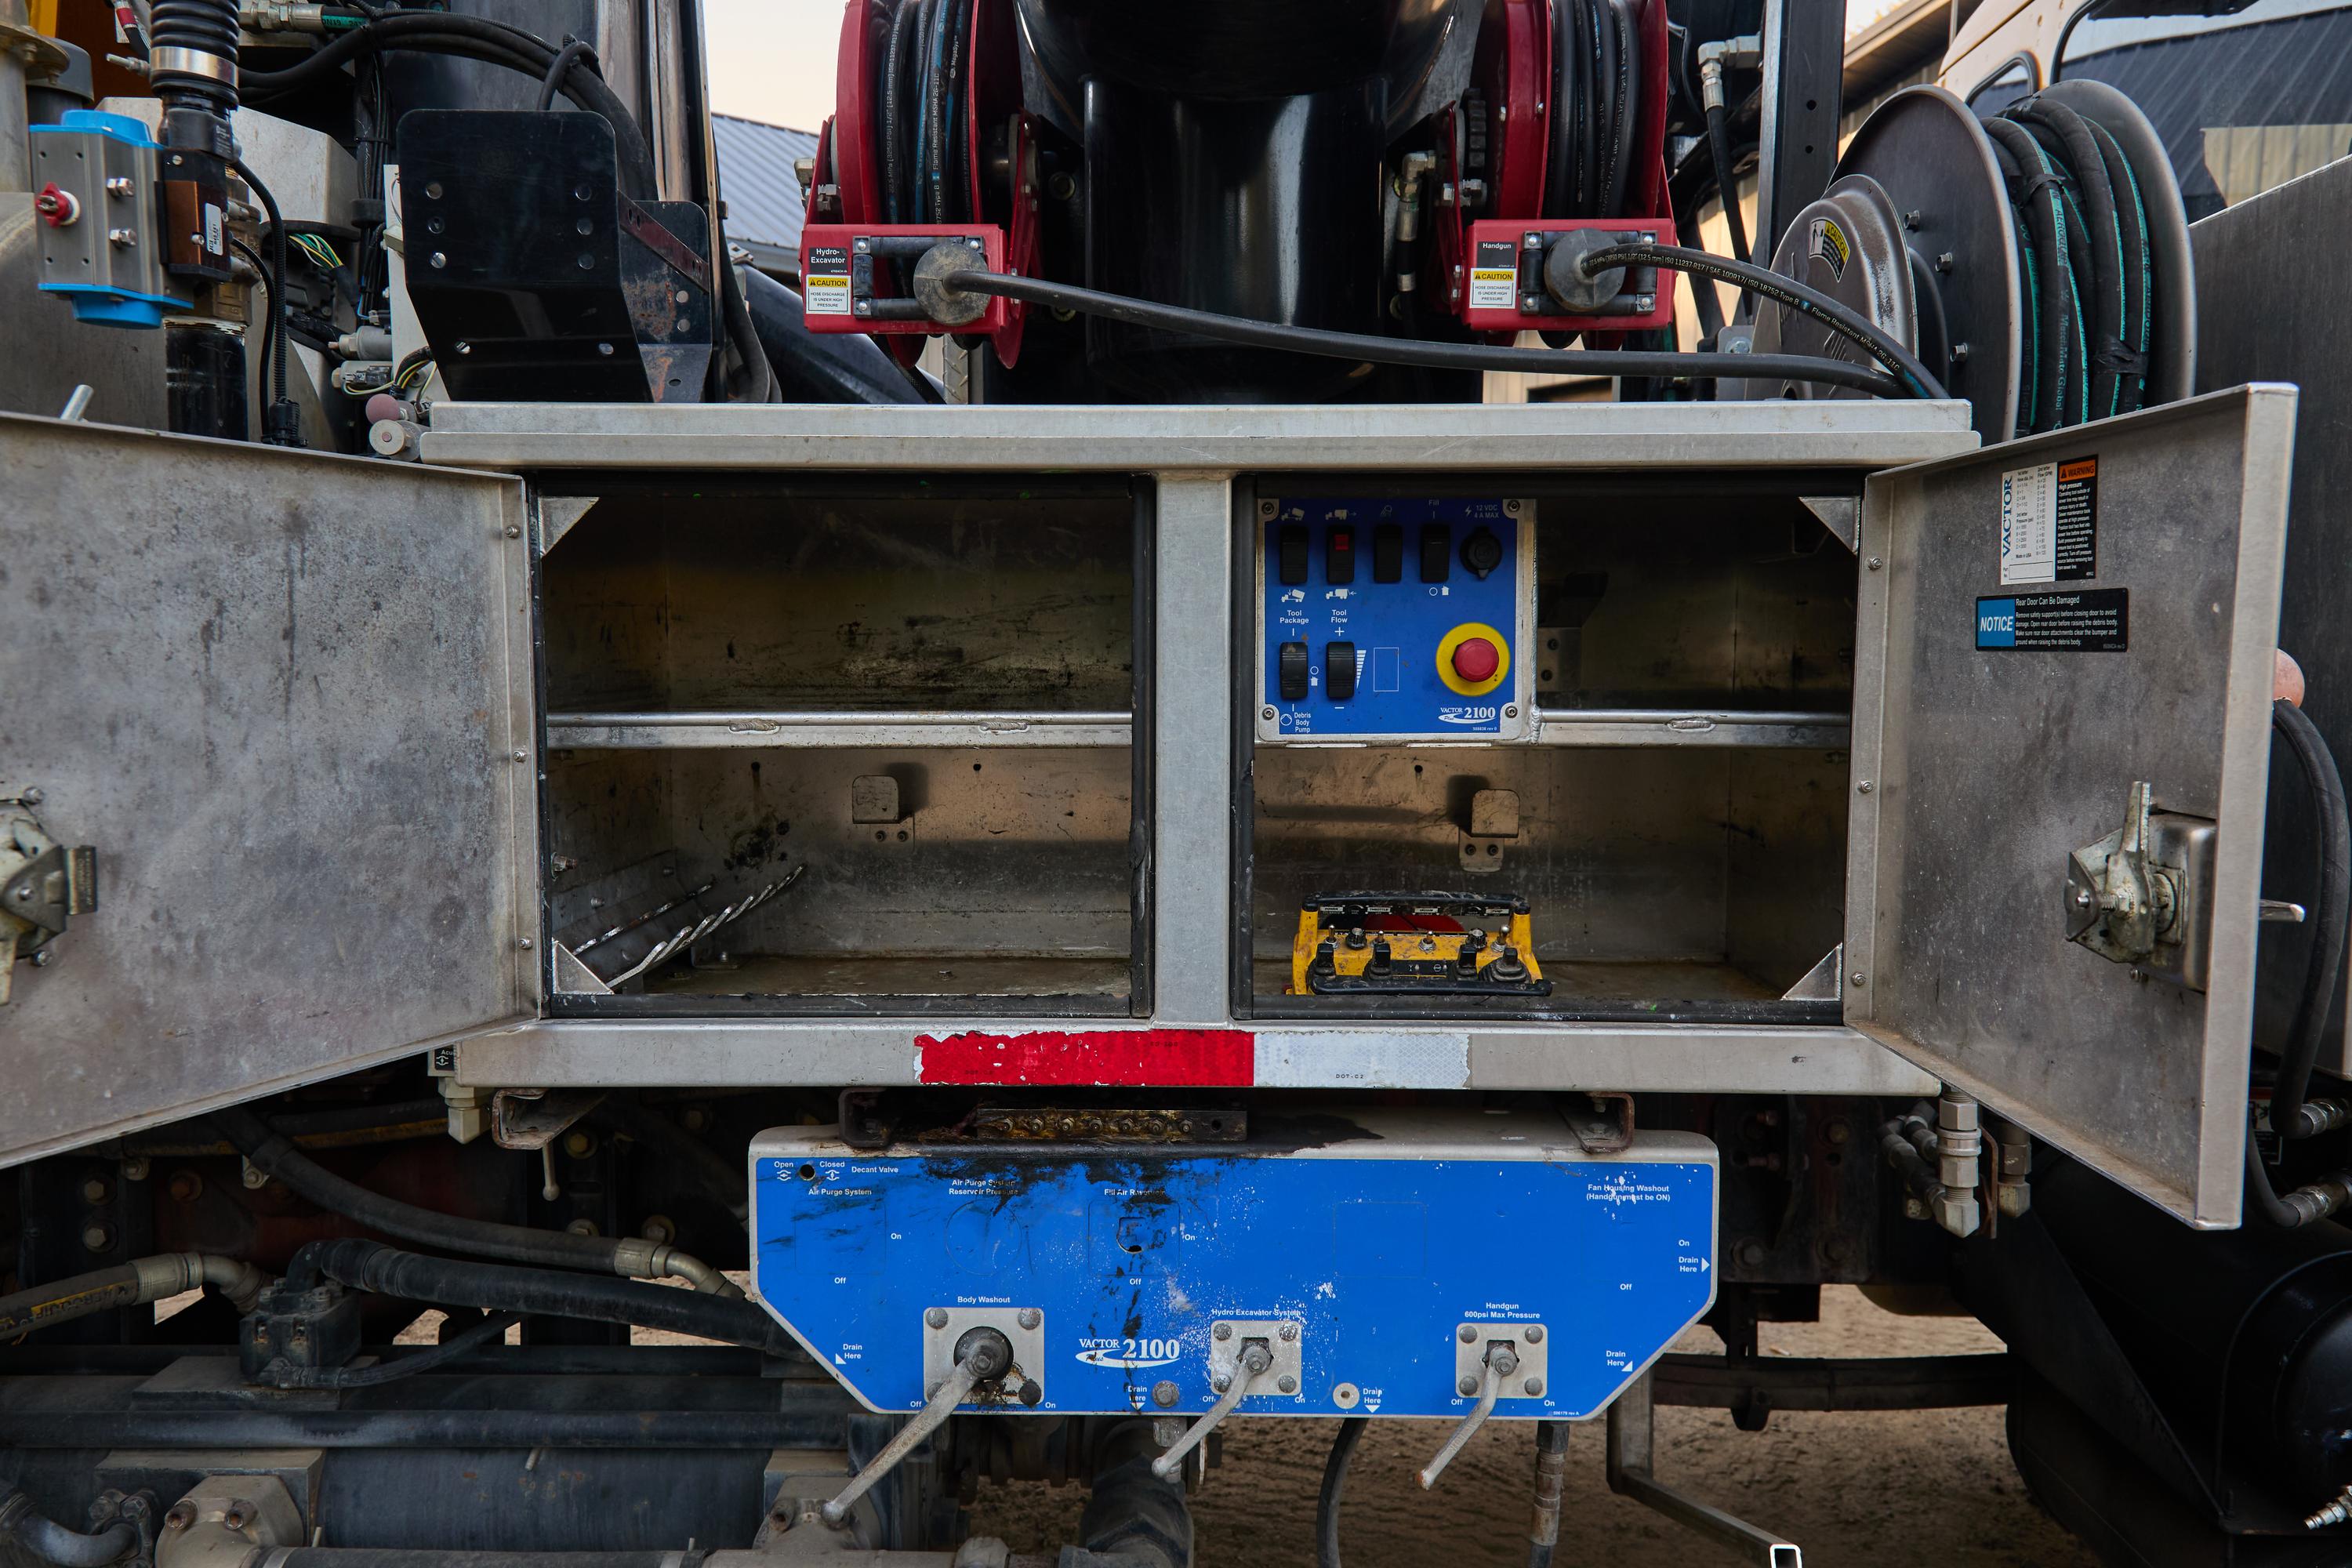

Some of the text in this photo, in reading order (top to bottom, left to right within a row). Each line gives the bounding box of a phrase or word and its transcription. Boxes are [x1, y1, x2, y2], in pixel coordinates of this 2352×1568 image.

[1830, 227, 1847, 256] CAUTION
[1759, 284, 1779, 296] 18752
[1780, 292, 1793, 303] Type
[1812, 307, 1831, 321] Flame
[1831, 318, 1860, 339] Resistant
[2056, 376, 2067, 411] Global
[2068, 465, 2095, 477] WARNING
[2003, 475, 2012, 558] VACTOR
[2056, 596, 2080, 606] Damaged
[1980, 616, 2013, 632] NOTICE
[1464, 707, 1496, 718] 2100
[844, 1189, 872, 1197] System
[1079, 1338, 1180, 1359] VACTOR 2100
